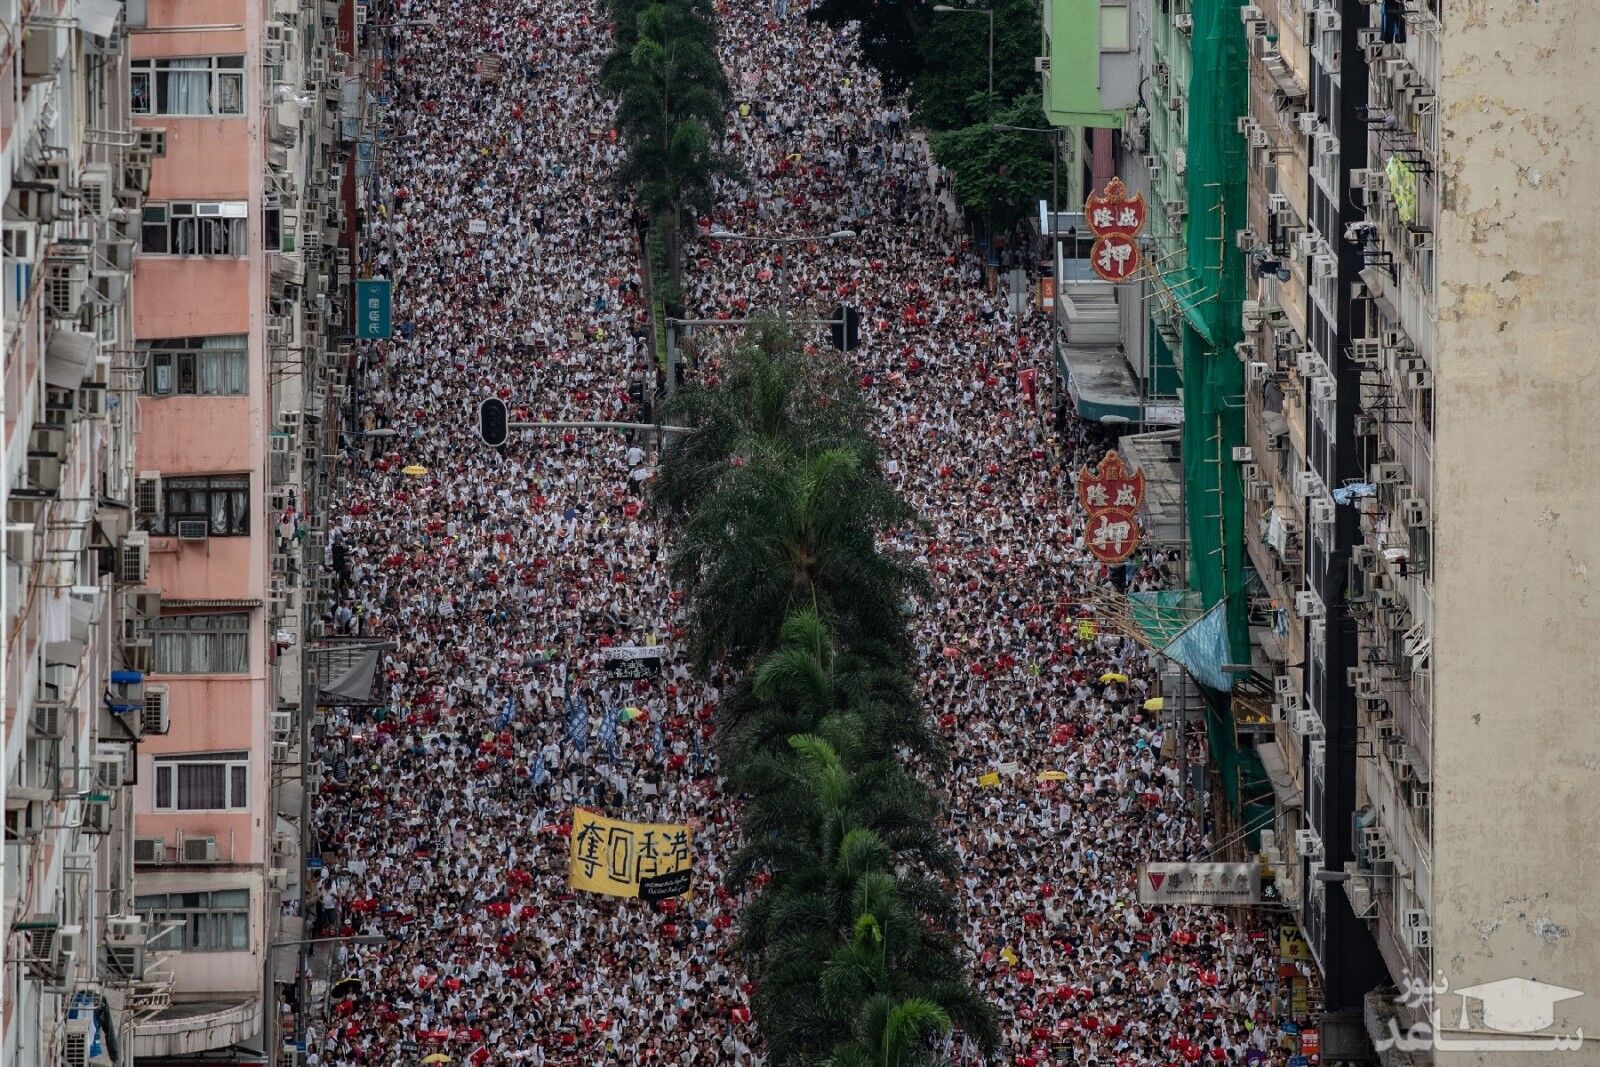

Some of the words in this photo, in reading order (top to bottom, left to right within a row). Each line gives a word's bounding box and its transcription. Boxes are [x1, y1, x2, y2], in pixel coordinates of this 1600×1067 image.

[1097, 239, 1132, 276] 押
[1092, 515, 1131, 554] 押
[576, 821, 690, 885] 奪回香港
